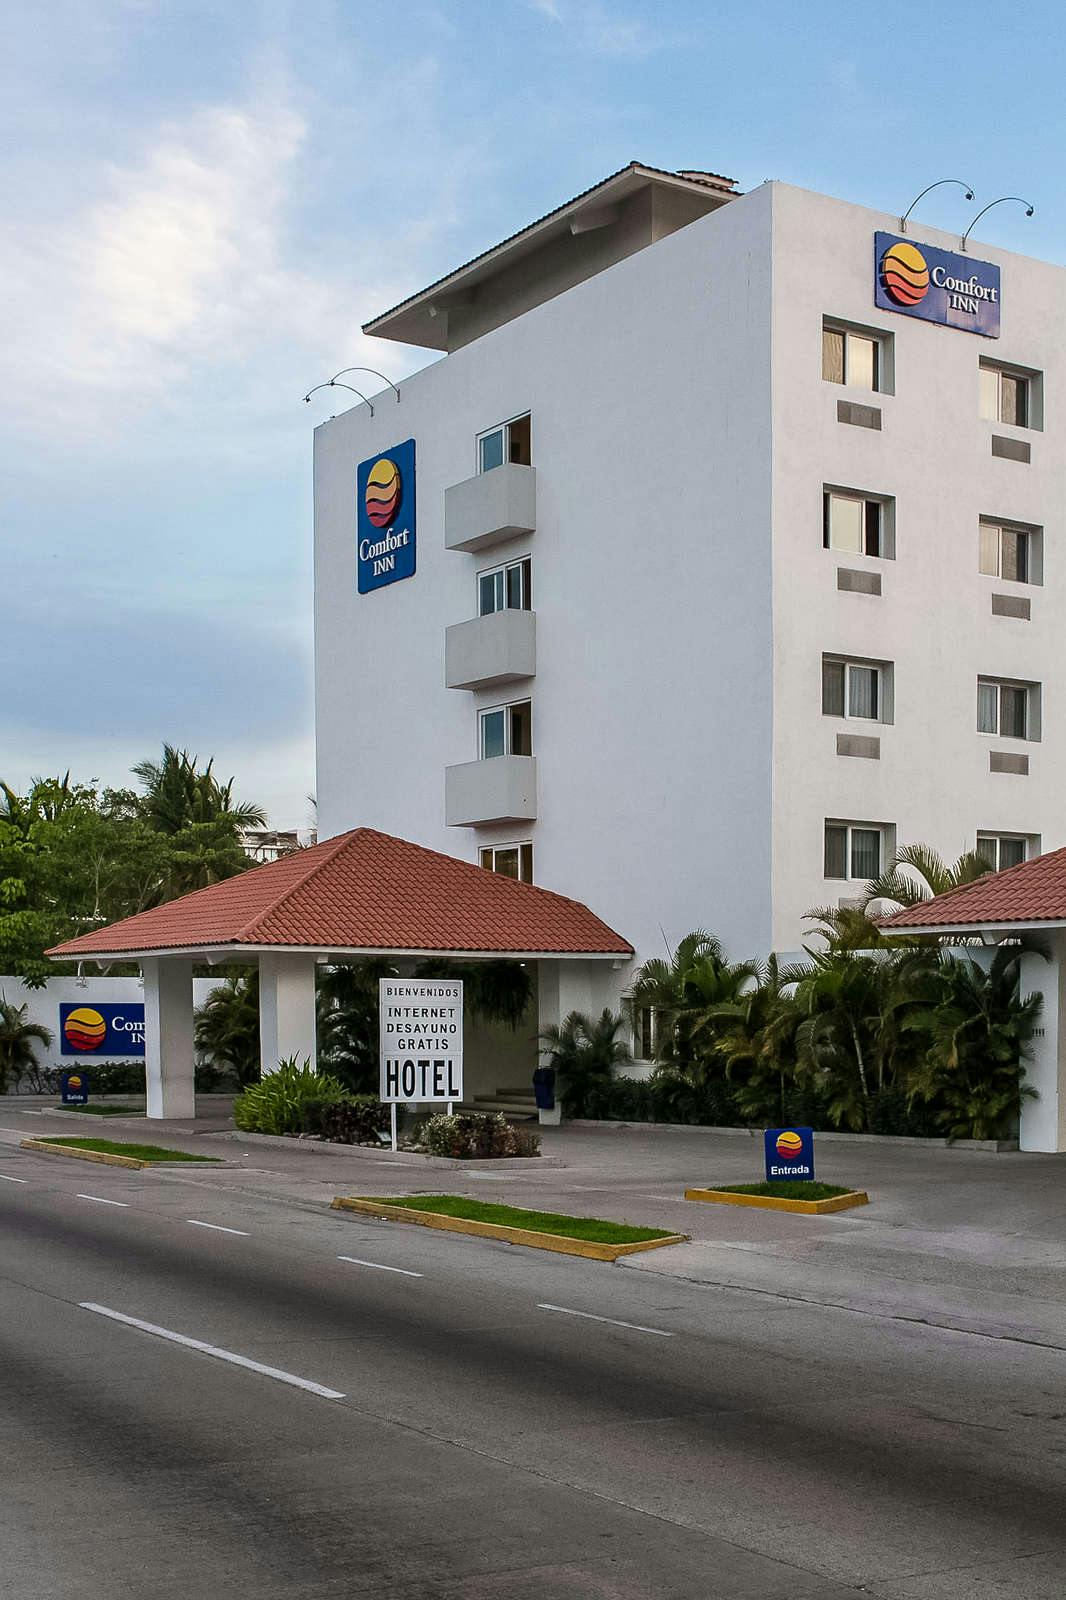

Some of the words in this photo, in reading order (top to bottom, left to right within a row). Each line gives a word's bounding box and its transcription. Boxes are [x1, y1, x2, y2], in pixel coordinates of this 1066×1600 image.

[931, 266, 998, 303] Comfort
[951, 294, 979, 313] INN
[360, 527, 410, 561] Comfort
[373, 554, 395, 576] INN
[386, 987, 459, 997] BIENVENIDOS
[388, 1007, 455, 1018] INTERNET
[386, 1023, 457, 1034] DESAYUNO
[398, 1038, 449, 1050] GRATIS
[386, 1059, 459, 1097] HOTEL
[770, 1165, 810, 1175] Entrada
